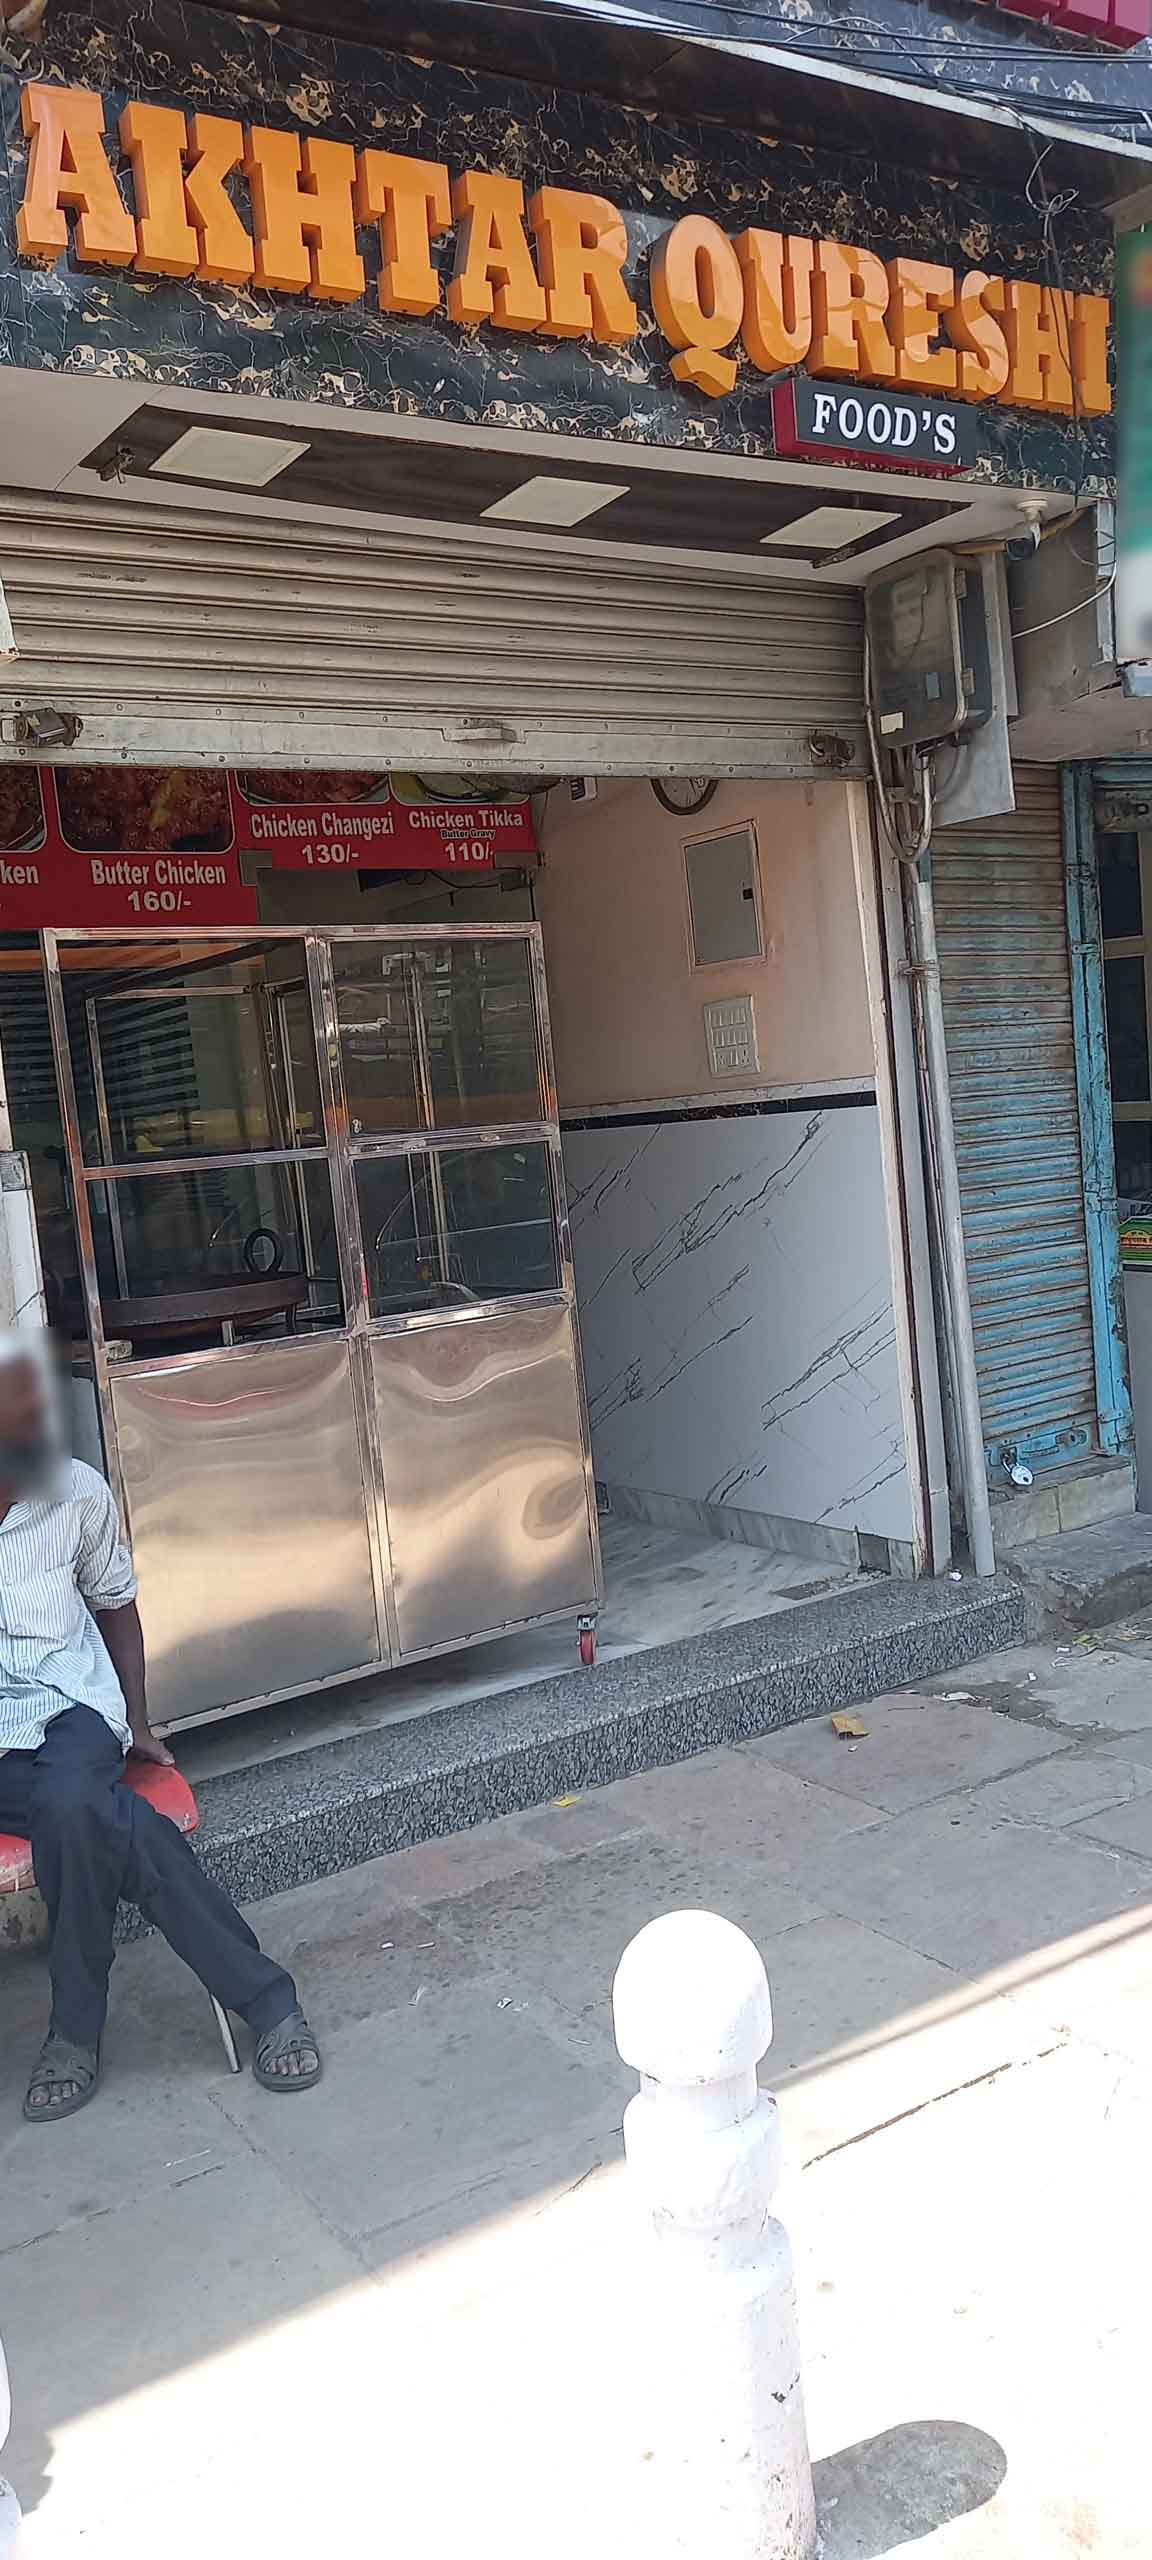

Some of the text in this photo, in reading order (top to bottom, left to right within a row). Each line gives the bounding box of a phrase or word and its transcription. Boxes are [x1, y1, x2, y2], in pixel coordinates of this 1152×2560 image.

[16, 81, 1112, 417] AKHTAR QURESHI
[812, 393, 956, 454] FOOD'S
[251, 811, 395, 841] Chicken Changezi
[408, 809, 524, 829] Chicken Tikka
[470, 829, 496, 839] Gravy
[302, 843, 360, 864] 130/-
[91, 859, 226, 885] Butter Chicken
[127, 890, 192, 912] 160/-
